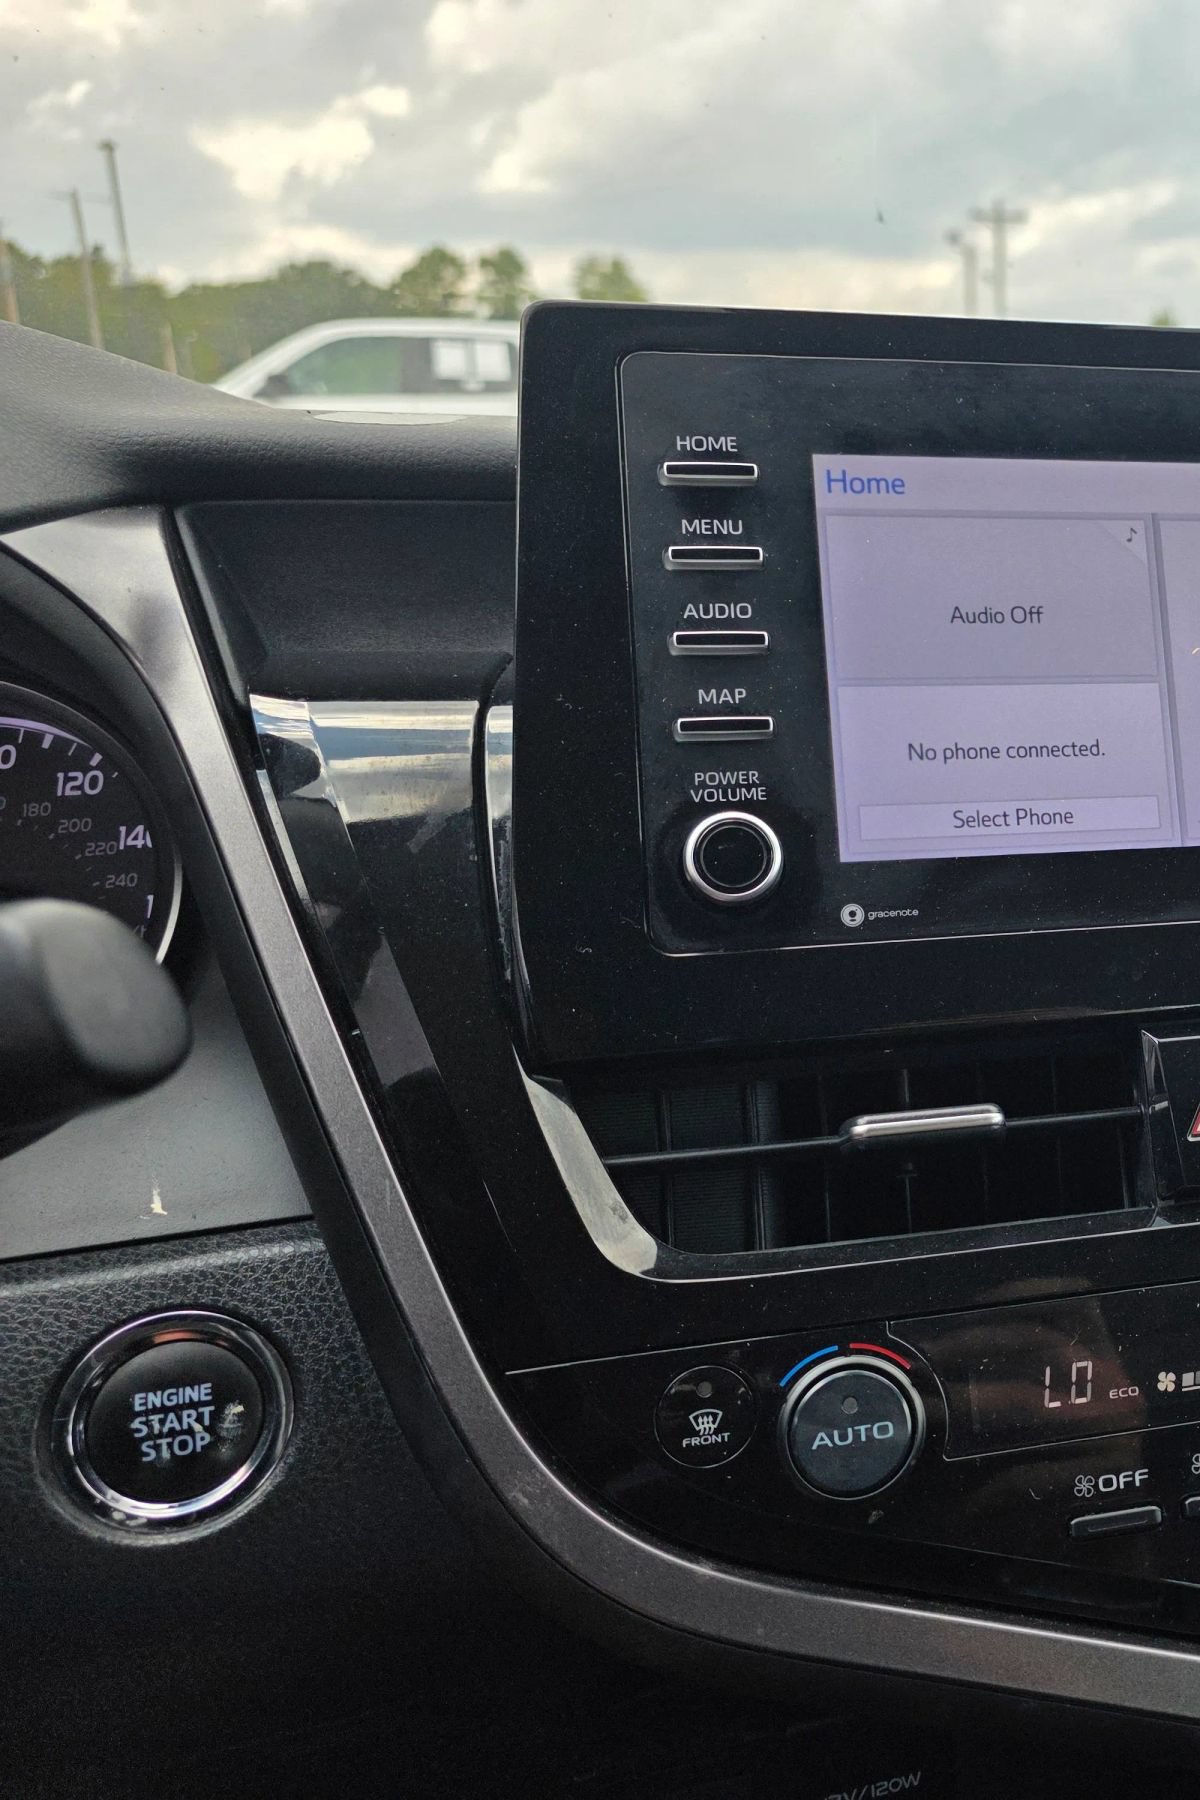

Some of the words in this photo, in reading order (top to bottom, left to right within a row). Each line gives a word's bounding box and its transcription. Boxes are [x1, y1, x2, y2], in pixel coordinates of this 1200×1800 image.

[675, 435, 738, 453] HOME
[825, 469, 906, 495] Home
[681, 519, 743, 535] MENU
[683, 602, 752, 619] AUDIO
[950, 605, 1005, 624] Audio
[1010, 605, 1044, 624] Off
[697, 688, 747, 705] MAP
[907, 742, 937, 761] No
[942, 742, 1001, 764] phone
[1006, 739, 1106, 759] connected.
[56, 770, 104, 797] 120
[694, 770, 760, 786] POWER
[690, 786, 767, 803] VOLUME
[22, 802, 52, 817] 180
[952, 809, 1011, 829] Select
[1015, 807, 1075, 826] Phone
[57, 818, 92, 834] 200
[84, 841, 118, 857] 220
[105, 873, 138, 889] 240
[867, 908, 919, 921] gracenote
[1044, 1360, 1093, 1409] LO
[1109, 1386, 1140, 1400] ECO
[133, 1382, 213, 1413] ENGINE
[130, 1405, 216, 1438] START
[682, 1432, 731, 1448] FRONT
[811, 1420, 894, 1450] AUTO
[140, 1431, 212, 1462] STOP
[1098, 1468, 1149, 1493] OFF
